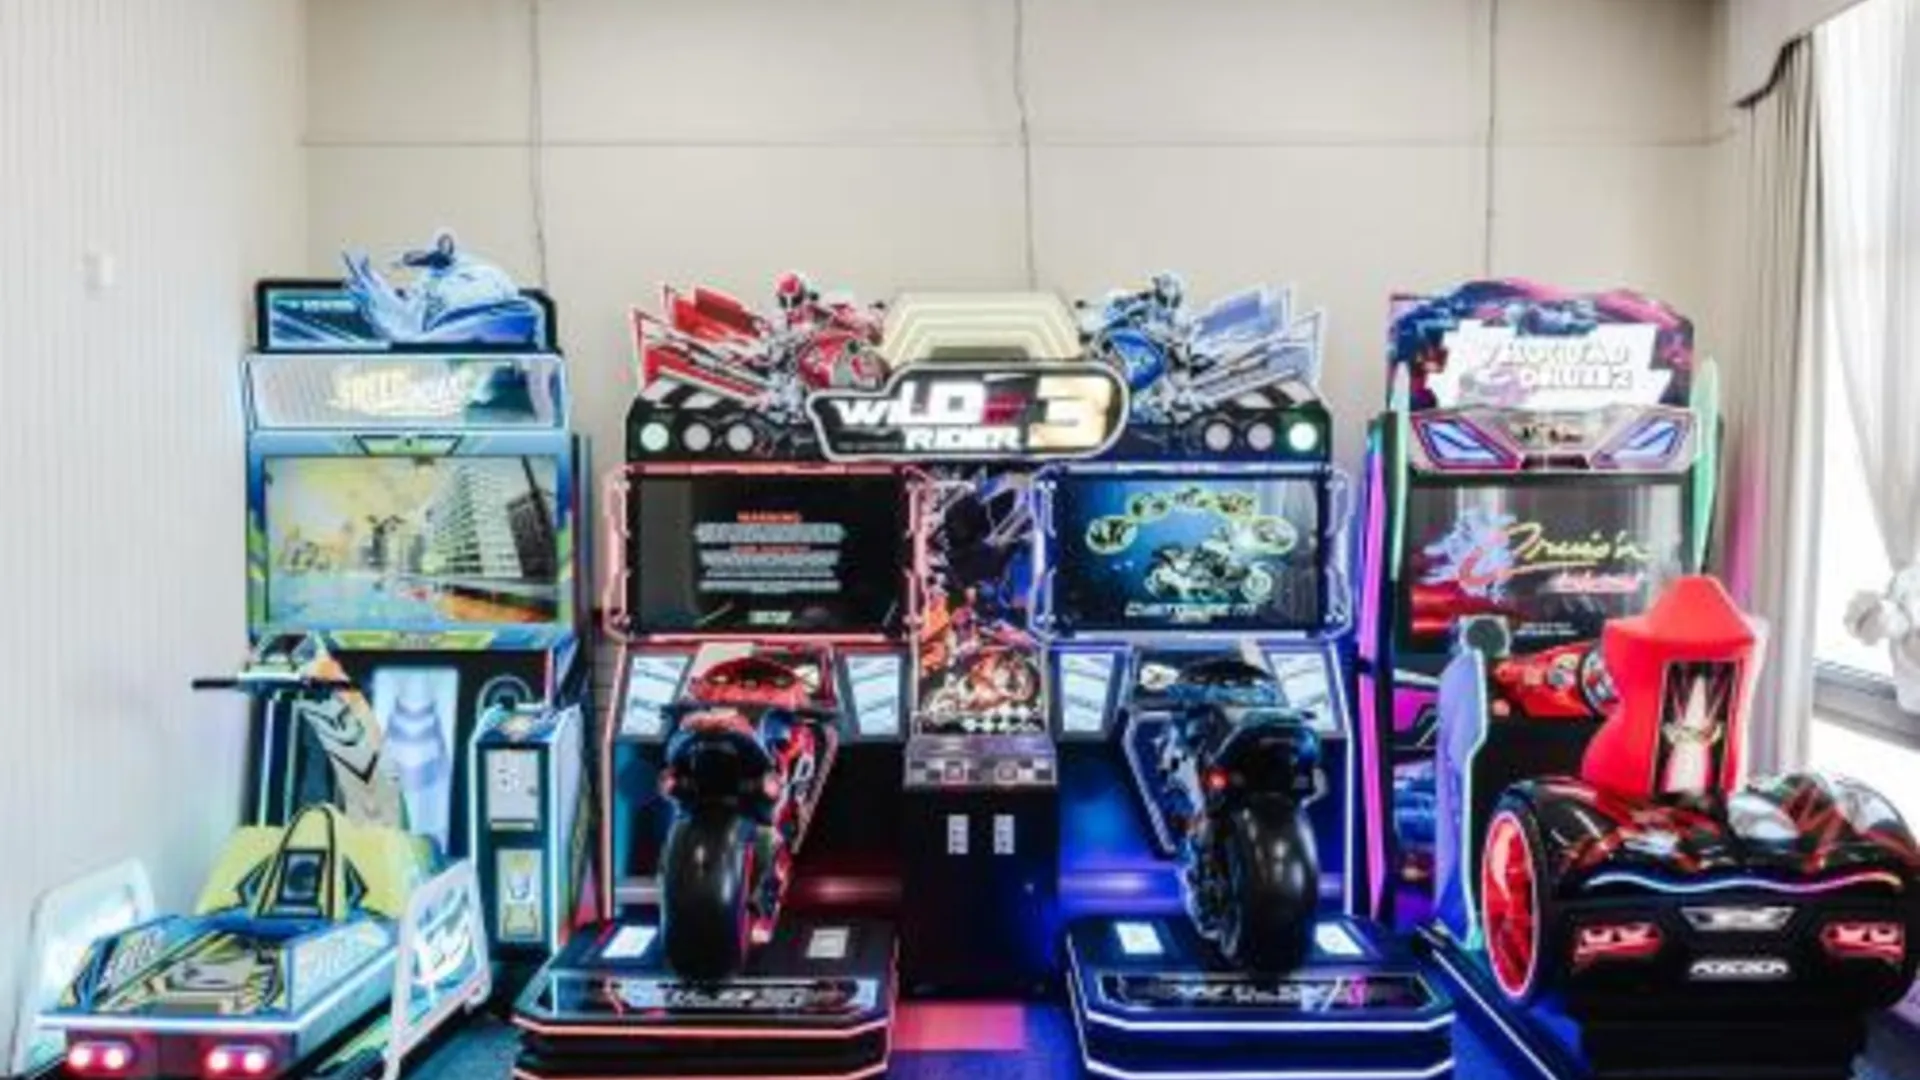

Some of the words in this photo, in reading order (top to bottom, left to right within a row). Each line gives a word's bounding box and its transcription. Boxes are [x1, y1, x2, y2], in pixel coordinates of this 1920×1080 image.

[829, 379, 985, 425] WILD
[1028, 375, 1112, 448] 3
[903, 427, 1021, 450] RIDER
